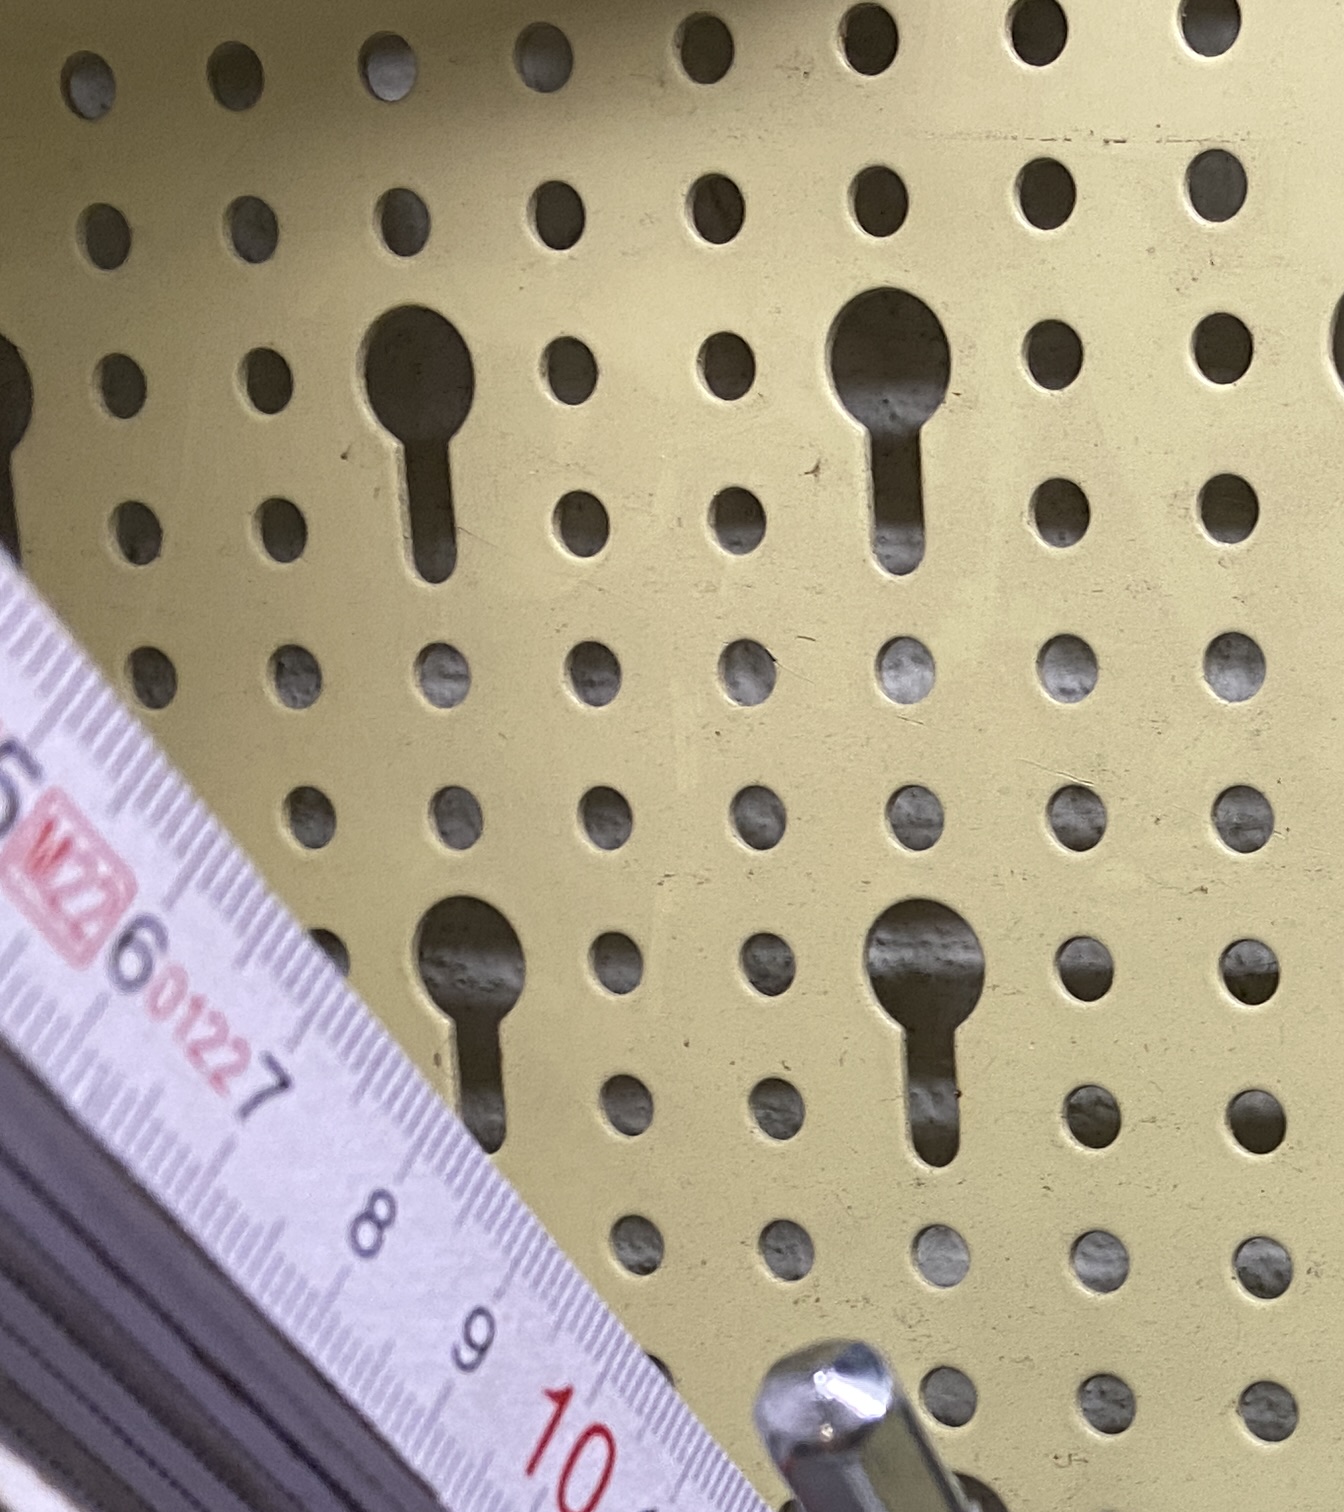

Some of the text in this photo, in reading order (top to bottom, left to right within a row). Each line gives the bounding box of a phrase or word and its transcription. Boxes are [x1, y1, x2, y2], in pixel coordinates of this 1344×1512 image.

[107, 914, 168, 993] 6
[146, 965, 250, 1098] 0122
[237, 1051, 293, 1120] 7
[348, 1188, 397, 1260] 8
[451, 1306, 496, 1373] 9
